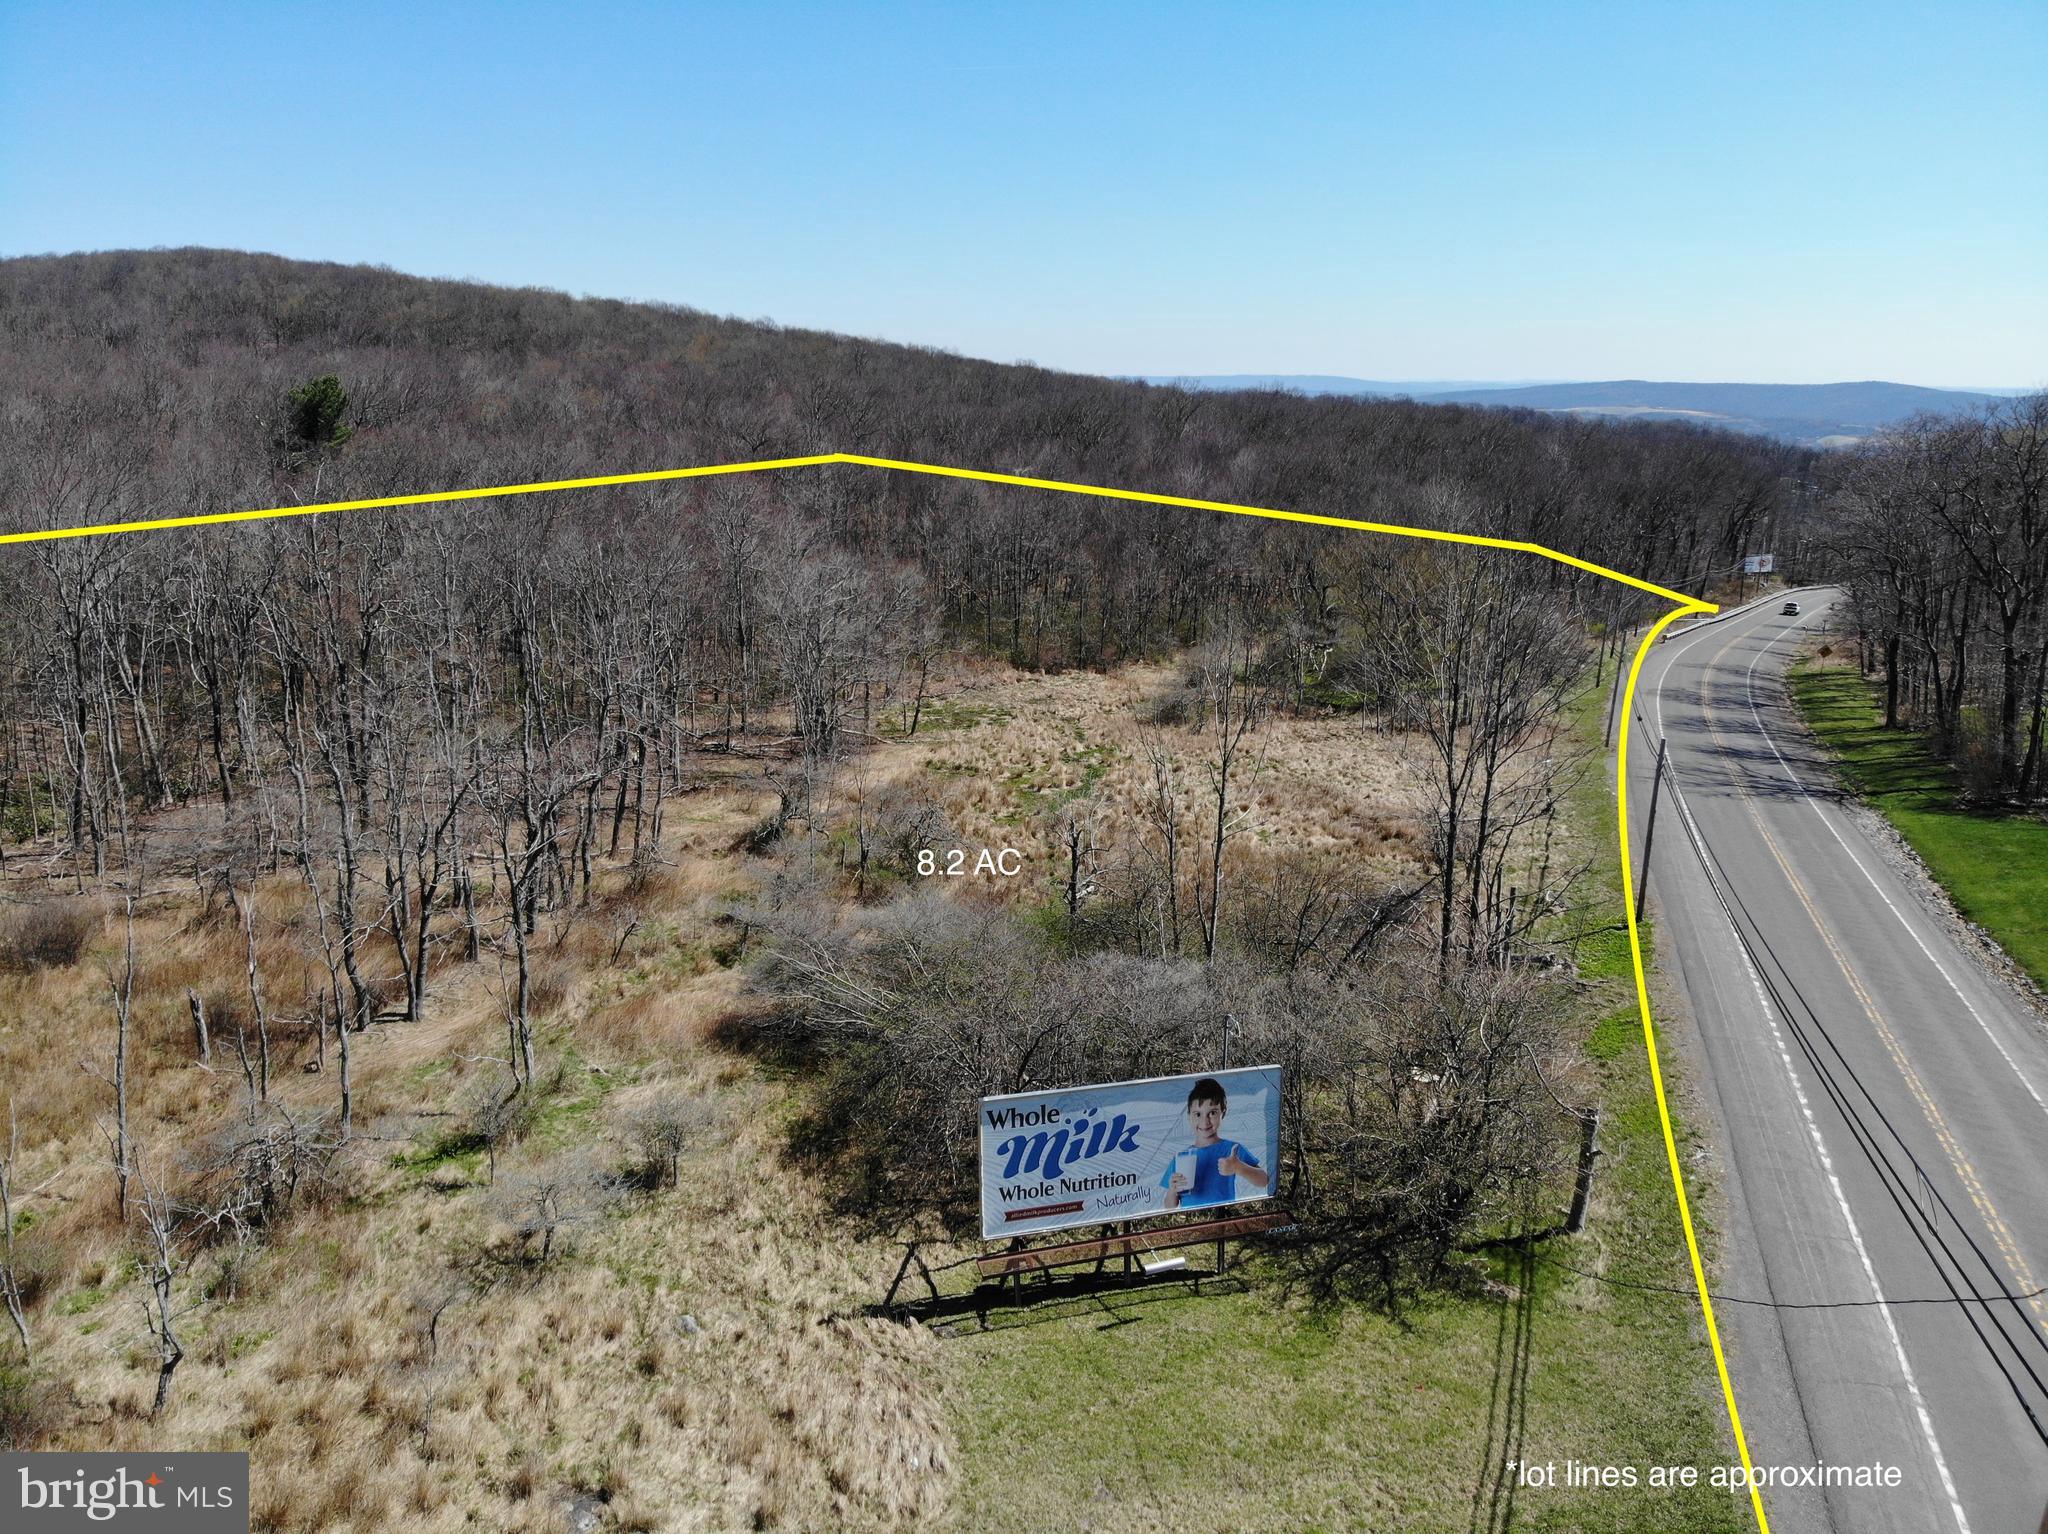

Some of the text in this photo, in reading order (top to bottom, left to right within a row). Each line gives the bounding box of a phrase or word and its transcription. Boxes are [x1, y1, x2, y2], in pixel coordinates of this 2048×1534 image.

[986, 1104, 1060, 1131] Whole
[996, 1113, 1141, 1180] Milk
[999, 1171, 1137, 1203] Whole Nutrition
[1096, 1184, 1151, 1210] Naturally
